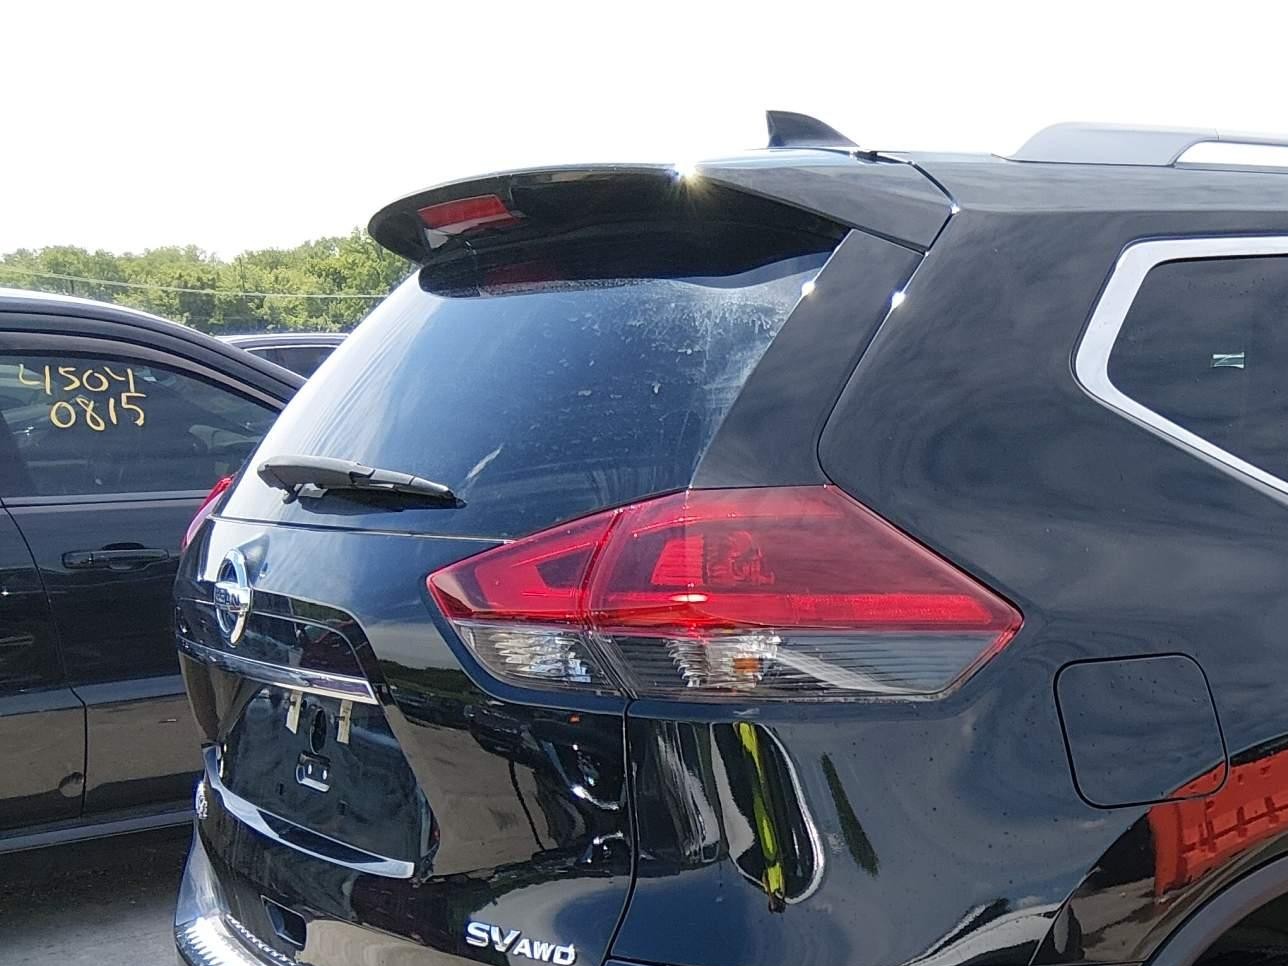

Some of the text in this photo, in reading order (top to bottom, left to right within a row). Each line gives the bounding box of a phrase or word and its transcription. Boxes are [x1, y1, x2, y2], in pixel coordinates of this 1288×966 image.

[50, 392, 147, 431] 0815
[465, 922, 577, 966] SV AWD
